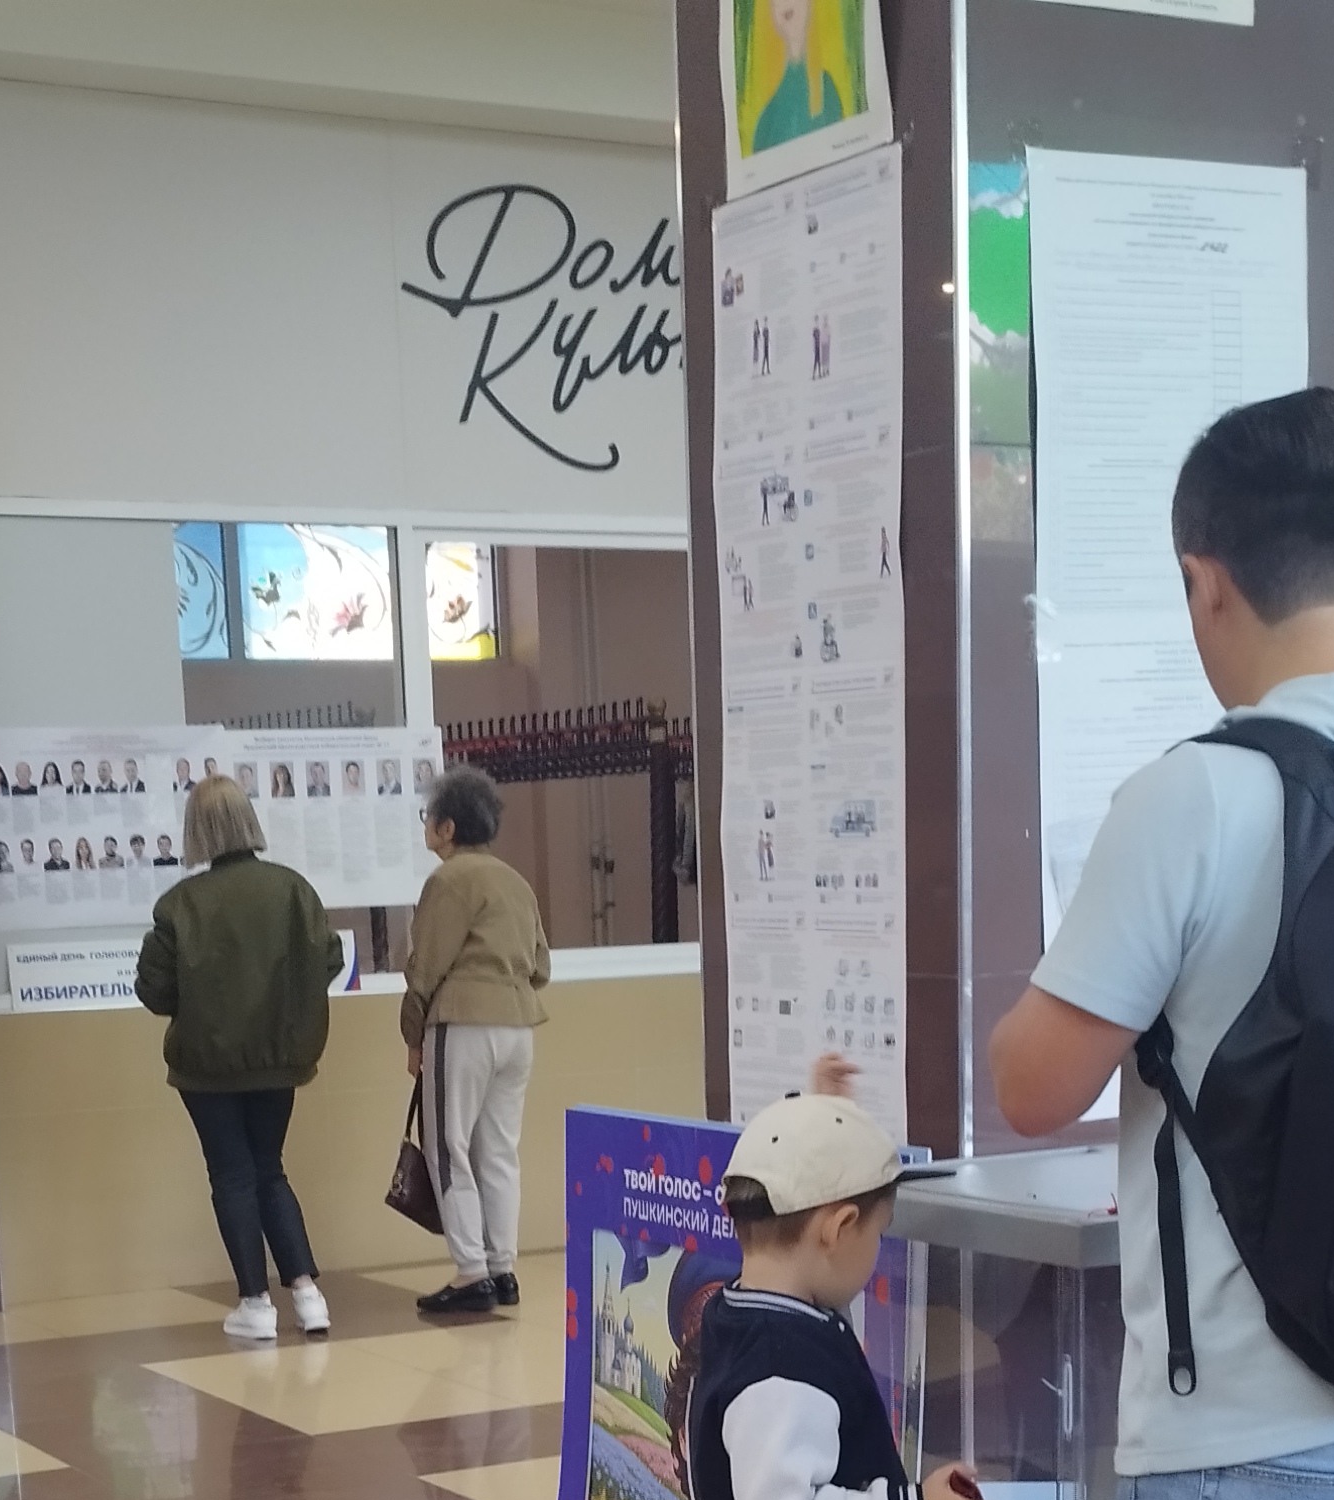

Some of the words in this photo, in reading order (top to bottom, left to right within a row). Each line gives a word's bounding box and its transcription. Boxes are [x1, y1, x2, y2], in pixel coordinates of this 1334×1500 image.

[401, 183, 681, 318] Дом
[459, 298, 685, 473] Куль
[16, 953, 58, 963] ЕДИНЫЙ
[60, 952, 85, 962] ДЕНЬ
[20, 983, 133, 1002] ИЗБИРАТЕЛЬ
[623, 1167, 656, 1195] ТВОЙ
[658, 1174, 702, 1202] ГОЛОС
[623, 1196, 709, 1234] ПУШКИНСКИЙ
